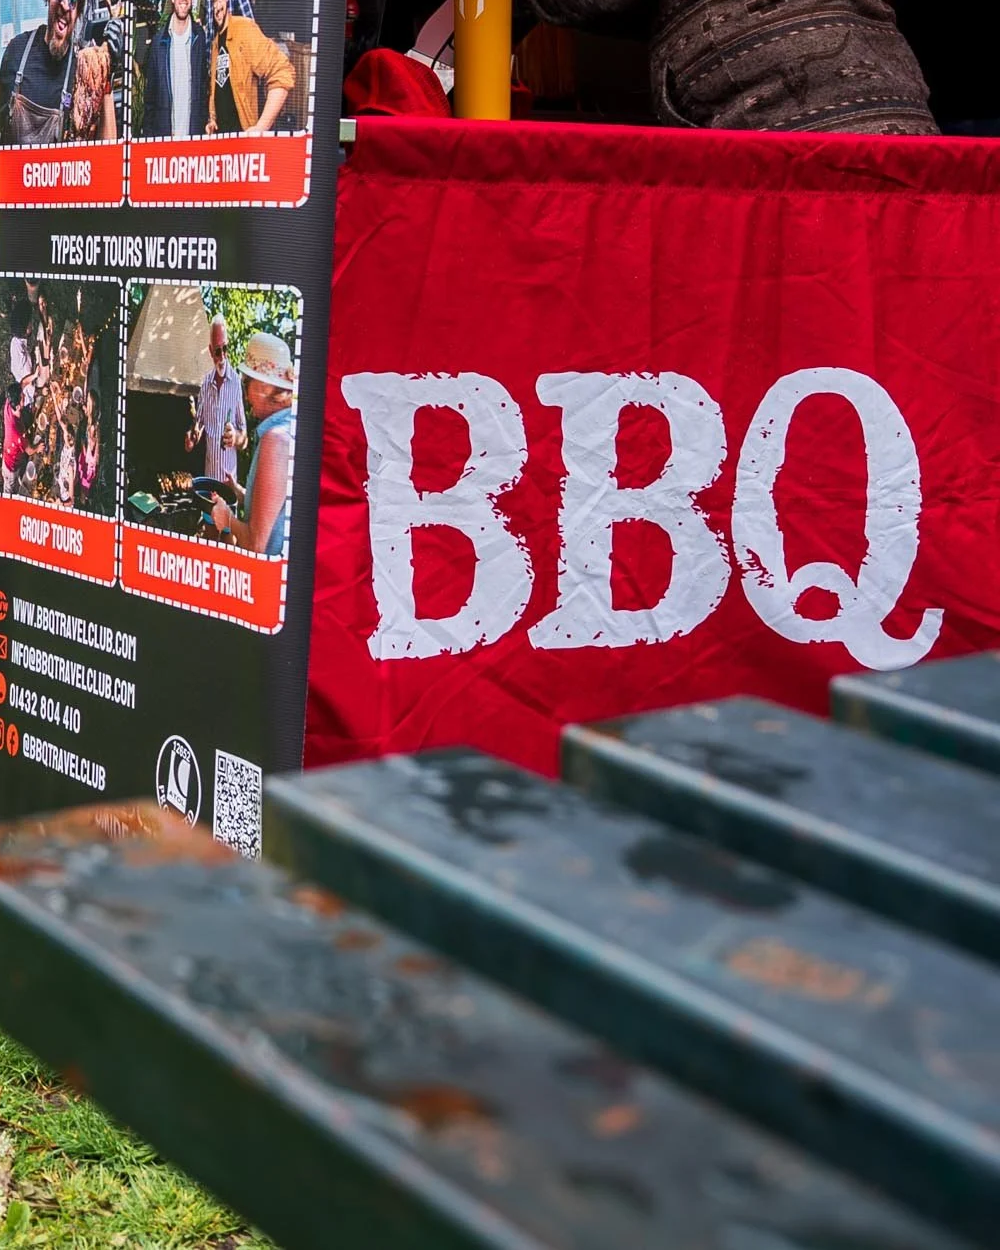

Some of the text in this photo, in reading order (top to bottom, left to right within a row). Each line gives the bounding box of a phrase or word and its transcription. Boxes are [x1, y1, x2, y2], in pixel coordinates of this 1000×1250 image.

[23, 160, 92, 188] GROUP TOURS
[145, 153, 271, 185] TAILORMADE TRAVEL
[51, 234, 217, 270] TYPES OF TOURS WE OFFER
[19, 514, 83, 557] GROUP TOURS
[341, 366, 944, 671] BBQ
[137, 546, 254, 605] TAILORMADE TRAVEL
[12, 597, 137, 662] WWW.BBQTRAVELCLUB.COM
[11, 640, 135, 709] INFO@BBQTRAVELCLUB.COM
[9, 683, 81, 734] 01432 804 410
[23, 733, 106, 791] @BBQTRAVELCLUB
[169, 790, 185, 807] ATOL
